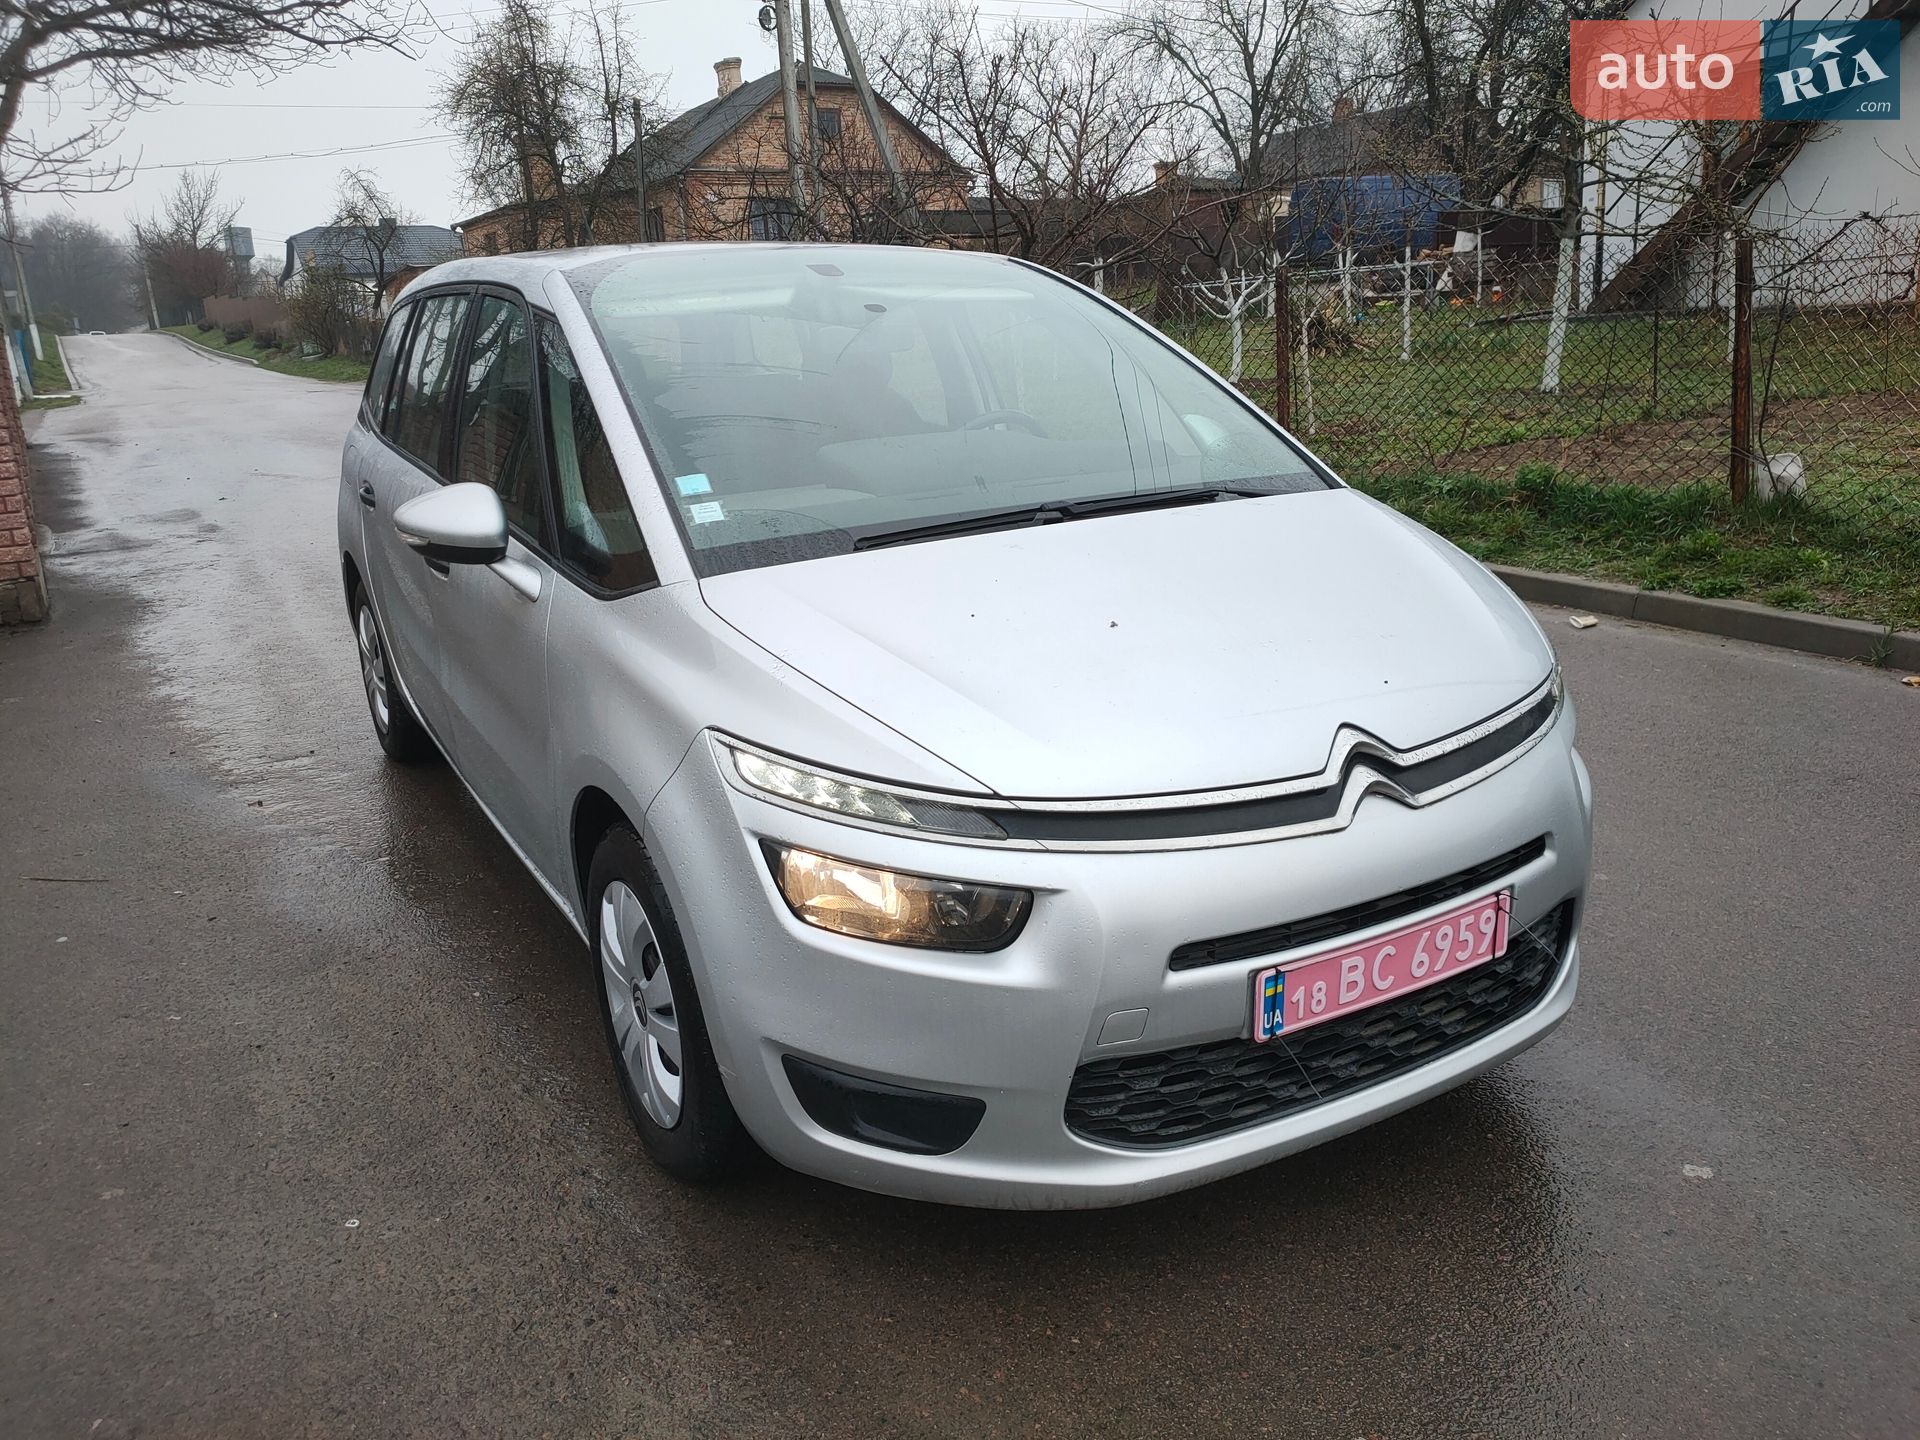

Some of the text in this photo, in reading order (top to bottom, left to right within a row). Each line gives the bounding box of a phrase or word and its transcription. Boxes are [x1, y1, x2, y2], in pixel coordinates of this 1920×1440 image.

[1290, 908, 1497, 1020] 18 BC 6959
[1263, 1008, 1283, 1029] UA
